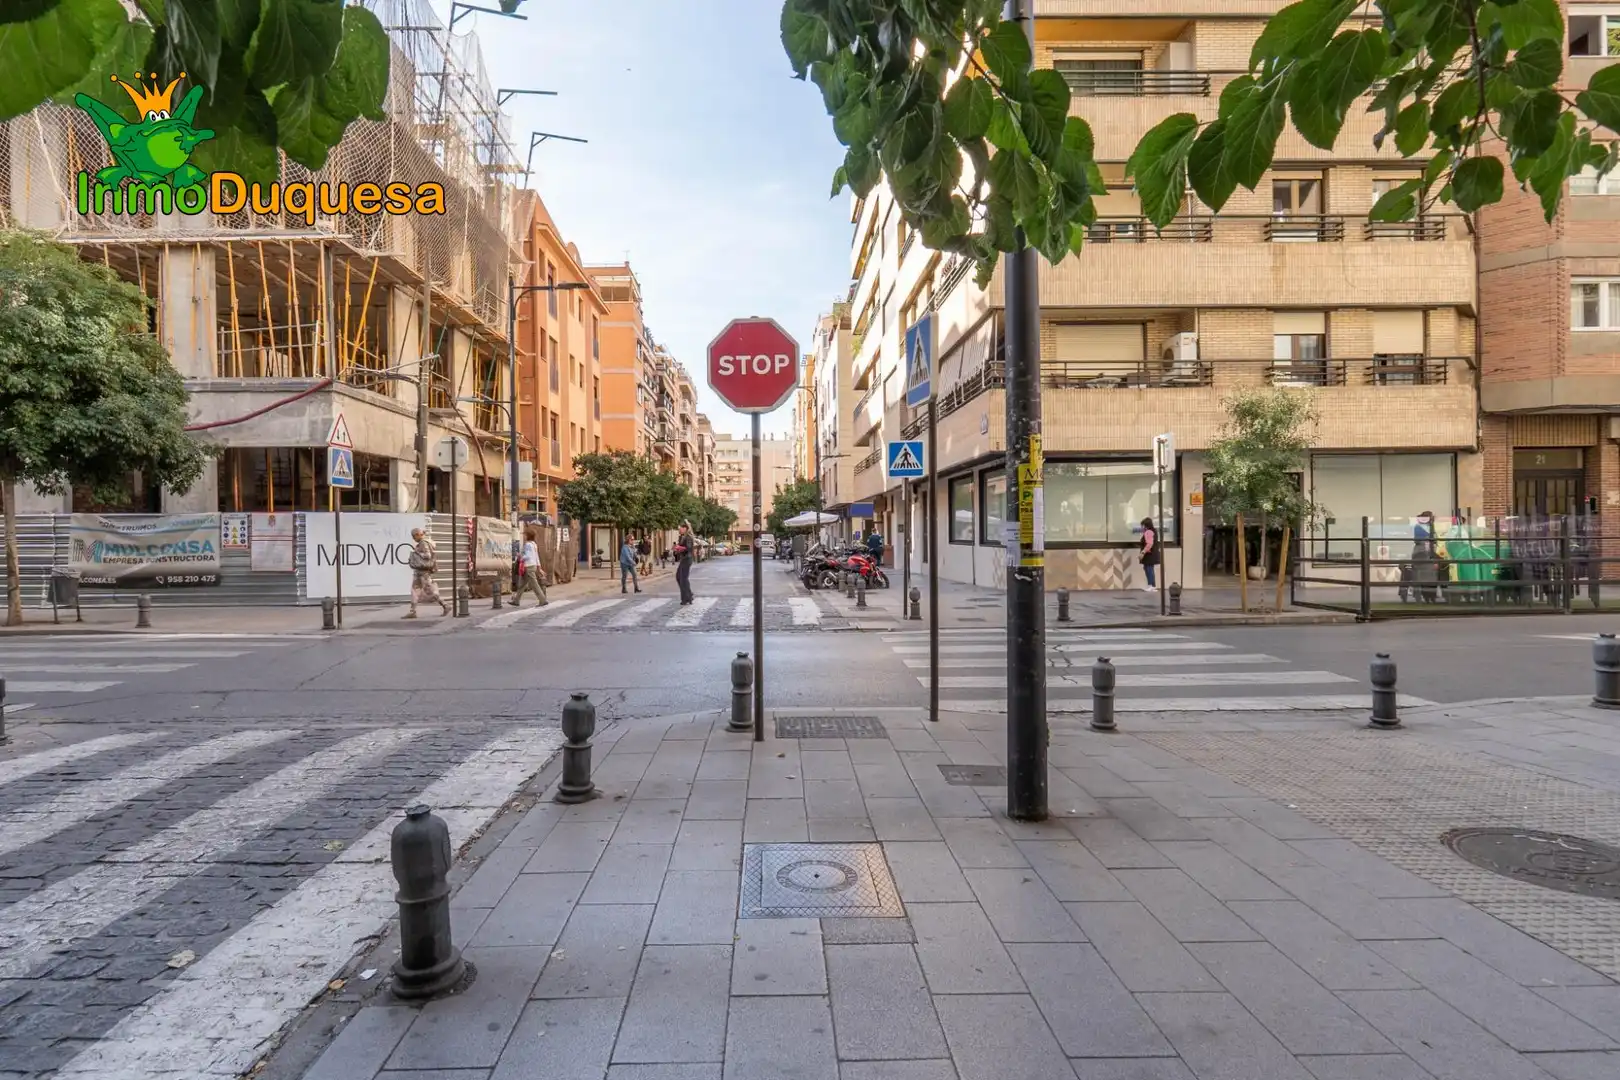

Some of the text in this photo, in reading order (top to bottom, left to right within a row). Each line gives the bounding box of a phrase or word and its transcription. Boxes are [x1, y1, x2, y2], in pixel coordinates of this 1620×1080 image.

[718, 354, 790, 376] STOP
[103, 540, 215, 555] MULCONSA
[103, 556, 144, 565] EMPRESA
[167, 575, 183, 583] 958
[200, 574, 216, 582] 475
